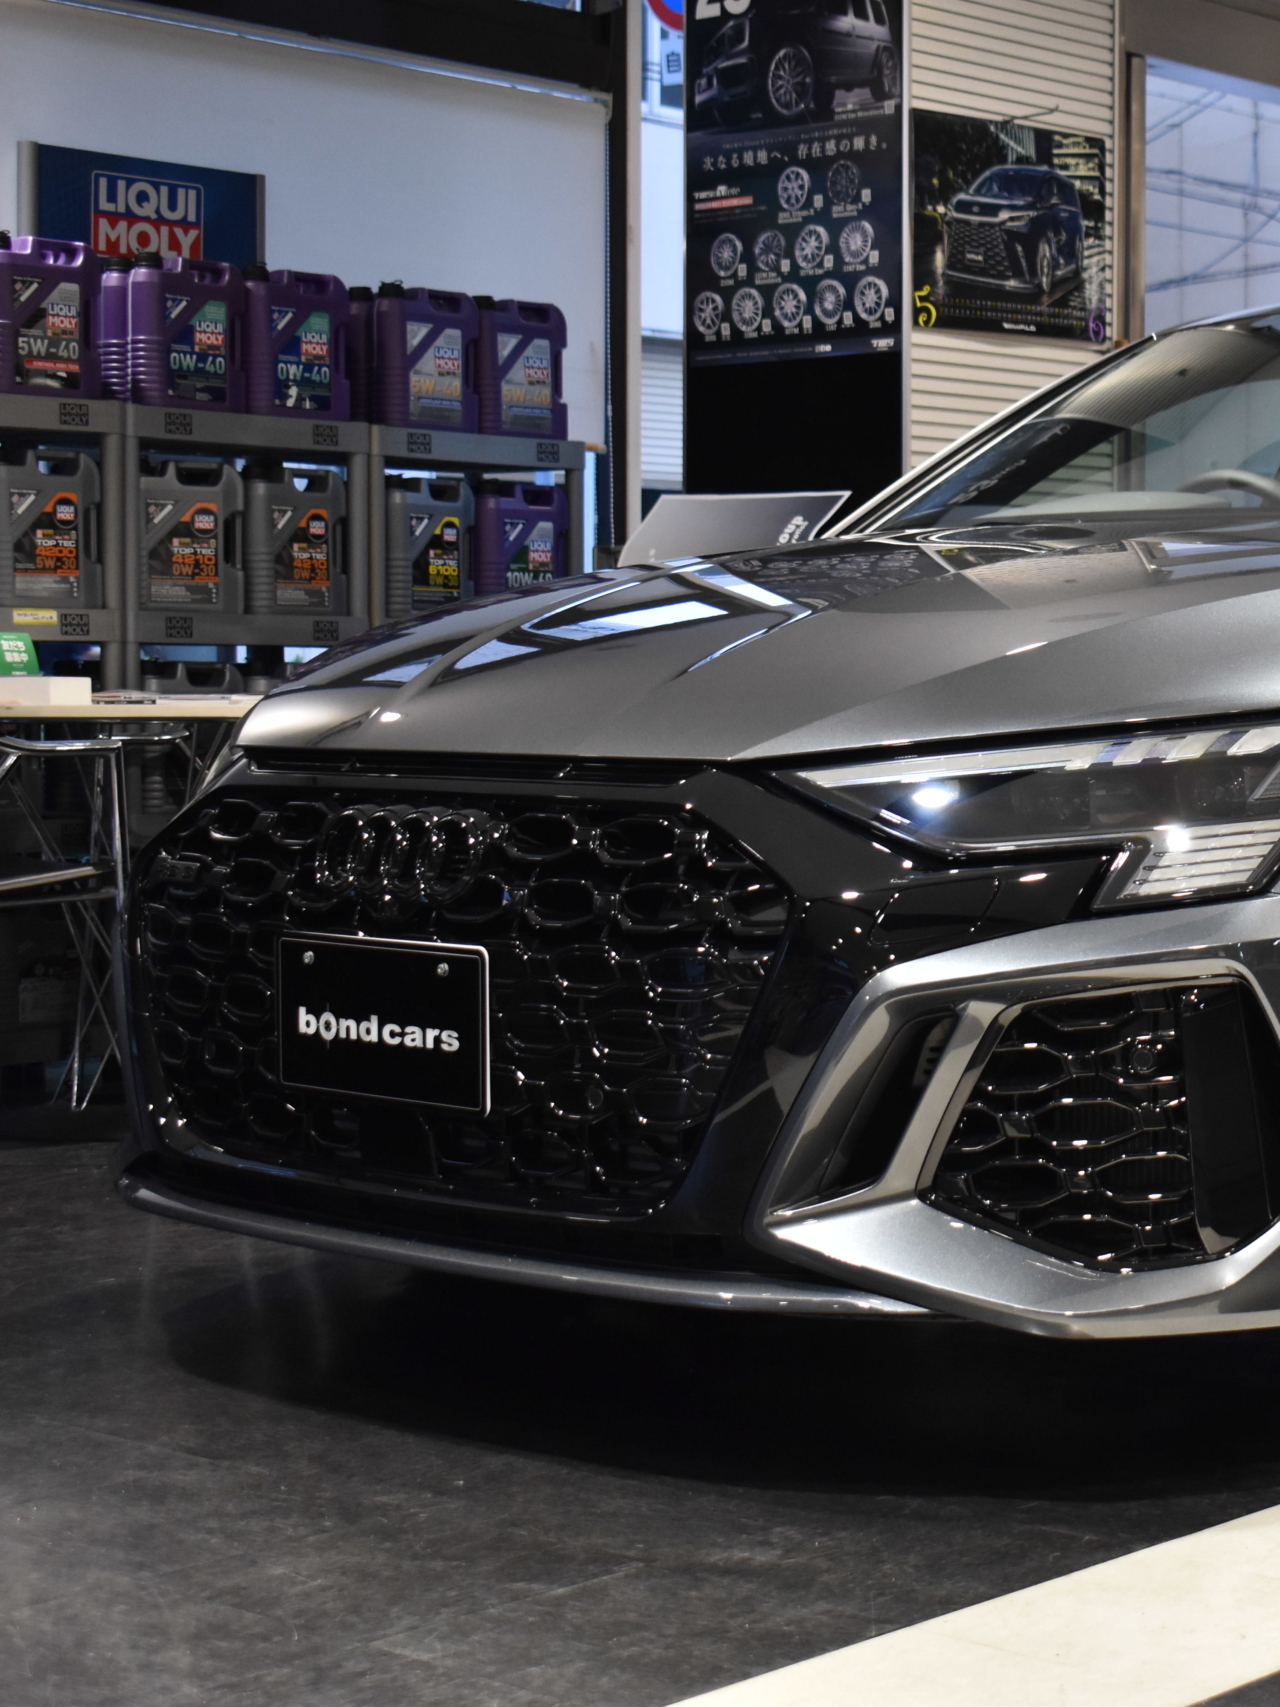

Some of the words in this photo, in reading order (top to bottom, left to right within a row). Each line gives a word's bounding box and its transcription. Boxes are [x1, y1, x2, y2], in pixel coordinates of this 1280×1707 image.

[98, 177, 197, 223] LIQUI
[98, 217, 200, 259] MOLY
[48, 304, 77, 316] LIQUI
[914, 284, 937, 327] 5
[48, 317, 78, 328] MOLY
[195, 321, 223, 332] LIQUI
[1089, 302, 1106, 342] 6
[195, 332, 224, 344] MOLY
[302, 332, 327, 343] LIQUI
[18, 337, 79, 359] 5W-40
[302, 343, 328, 355] MOLY
[435, 347, 460, 358] LIQUI
[170, 353, 226, 374] 0W-40
[435, 358, 460, 370] MOLY
[524, 357, 549, 368] LIQUI
[278, 363, 330, 384] 0W-40
[525, 368, 549, 380] MOLY
[411, 378, 461, 397] 5W-40
[61, 404, 88, 414] LIQUI
[61, 415, 88, 425] MOLY
[776, 516, 804, 546] oup
[529, 541, 551, 551] LIQUI
[35, 547, 76, 557] 4200
[529, 551, 552, 562] MOLY
[36, 557, 76, 569] 5W-30
[172, 555, 216, 564] 4210
[293, 560, 327, 568] 4210
[172, 565, 215, 576] 0W-30
[294, 569, 327, 580] 0W-30
[429, 565, 458, 575] 6100
[62, 614, 89, 624] LIQUI
[62, 625, 89, 635] MOLY
